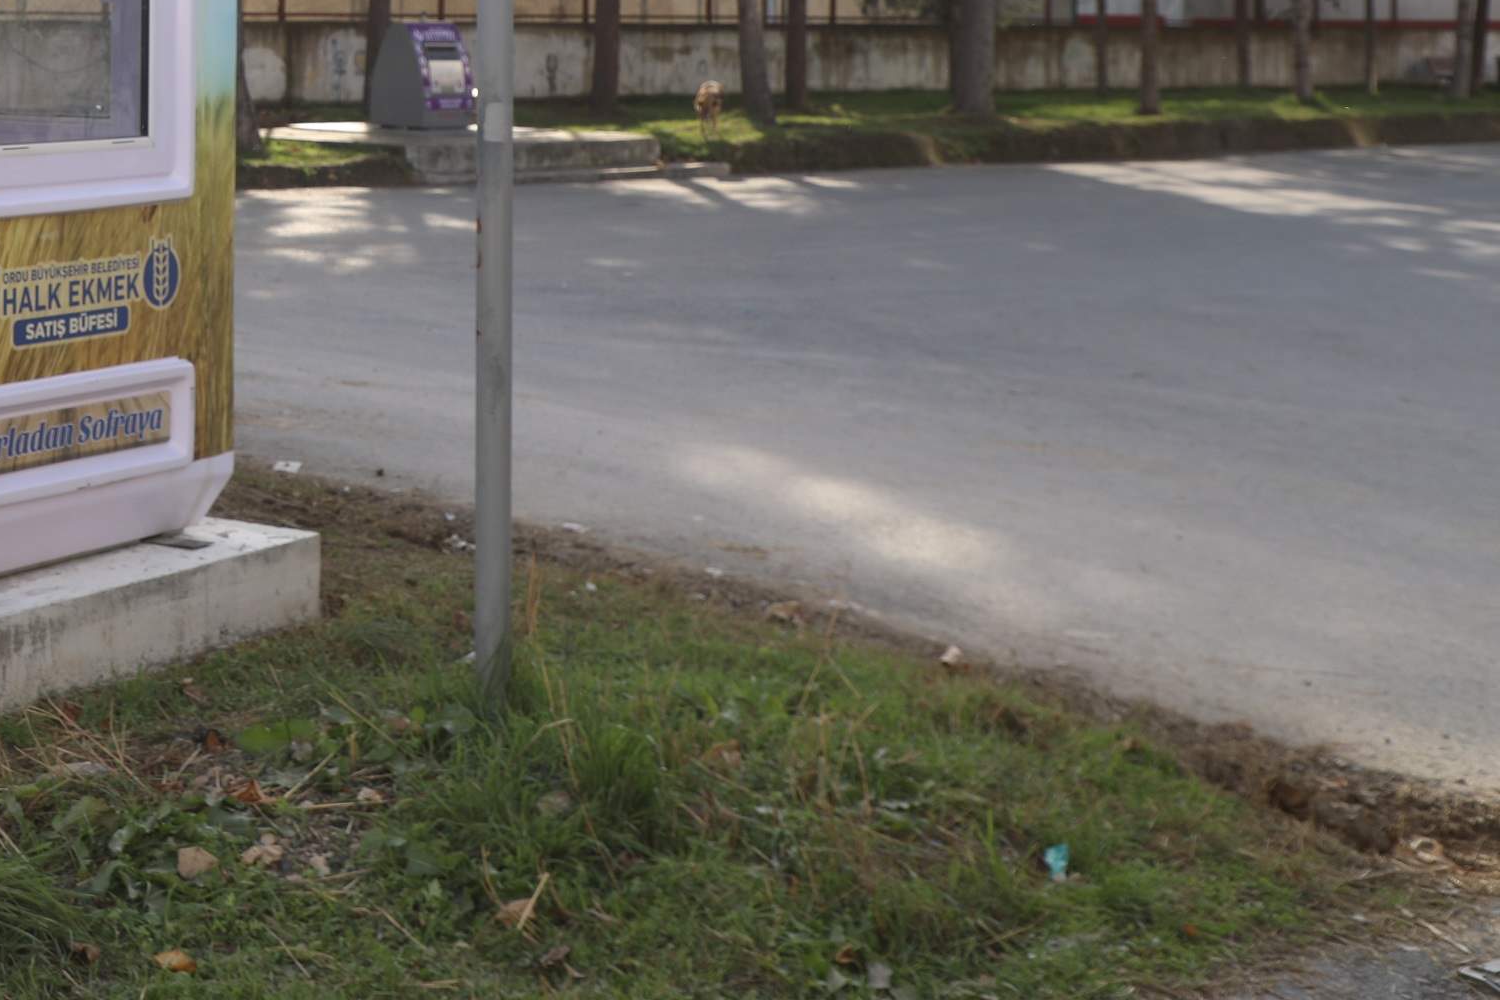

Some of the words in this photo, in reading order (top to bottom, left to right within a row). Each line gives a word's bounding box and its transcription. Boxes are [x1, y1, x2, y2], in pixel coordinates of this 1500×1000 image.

[3, 271, 29, 285] ORDU
[3, 282, 62, 315] HALK
[69, 273, 140, 307] EKMEK
[25, 319, 66, 340] SATIŞ
[69, 308, 118, 334] BÜFESİ
[78, 408, 163, 443] Sofraya
